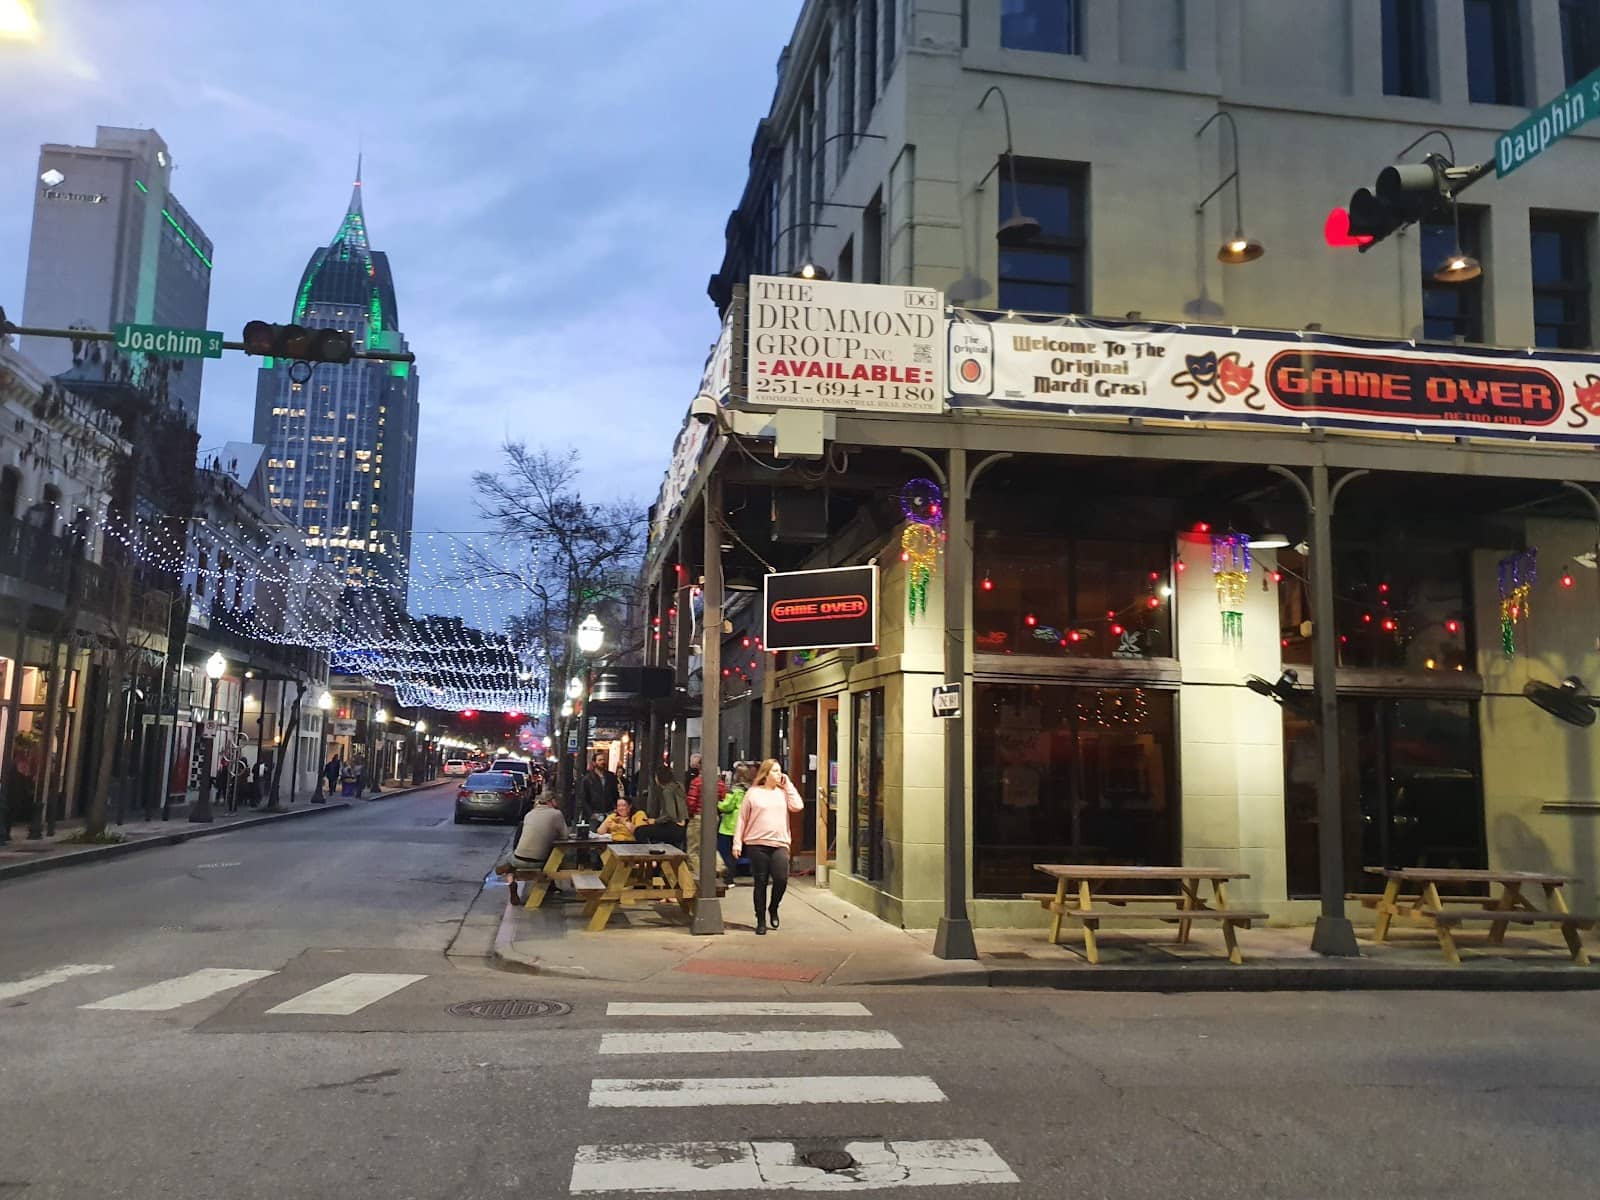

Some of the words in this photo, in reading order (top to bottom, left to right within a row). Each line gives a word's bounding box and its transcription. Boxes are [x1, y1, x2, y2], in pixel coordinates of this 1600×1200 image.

[1500, 93, 1585, 172] Dauphin
[1592, 80, 1600, 102] S
[757, 282, 812, 302] THE
[908, 293, 936, 307] DG
[757, 303, 935, 339] DRUMMOND
[117, 326, 202, 354] Joachim
[209, 338, 219, 350] St
[756, 333, 861, 359] GROUP
[954, 345, 988, 354] Original
[964, 336, 980, 345] The
[1012, 335, 1097, 354] Welcome
[1103, 341, 1126, 357] To
[1132, 342, 1166, 359] The
[1051, 358, 1129, 377] Original
[756, 378, 935, 401] 251-694-1180
[1032, 376, 1089, 394] Mardi
[1276, 366, 1412, 401] GAME
[1426, 376, 1553, 410] OVER
[774, 603, 818, 617] GAME
[821, 600, 865, 614] OVER
